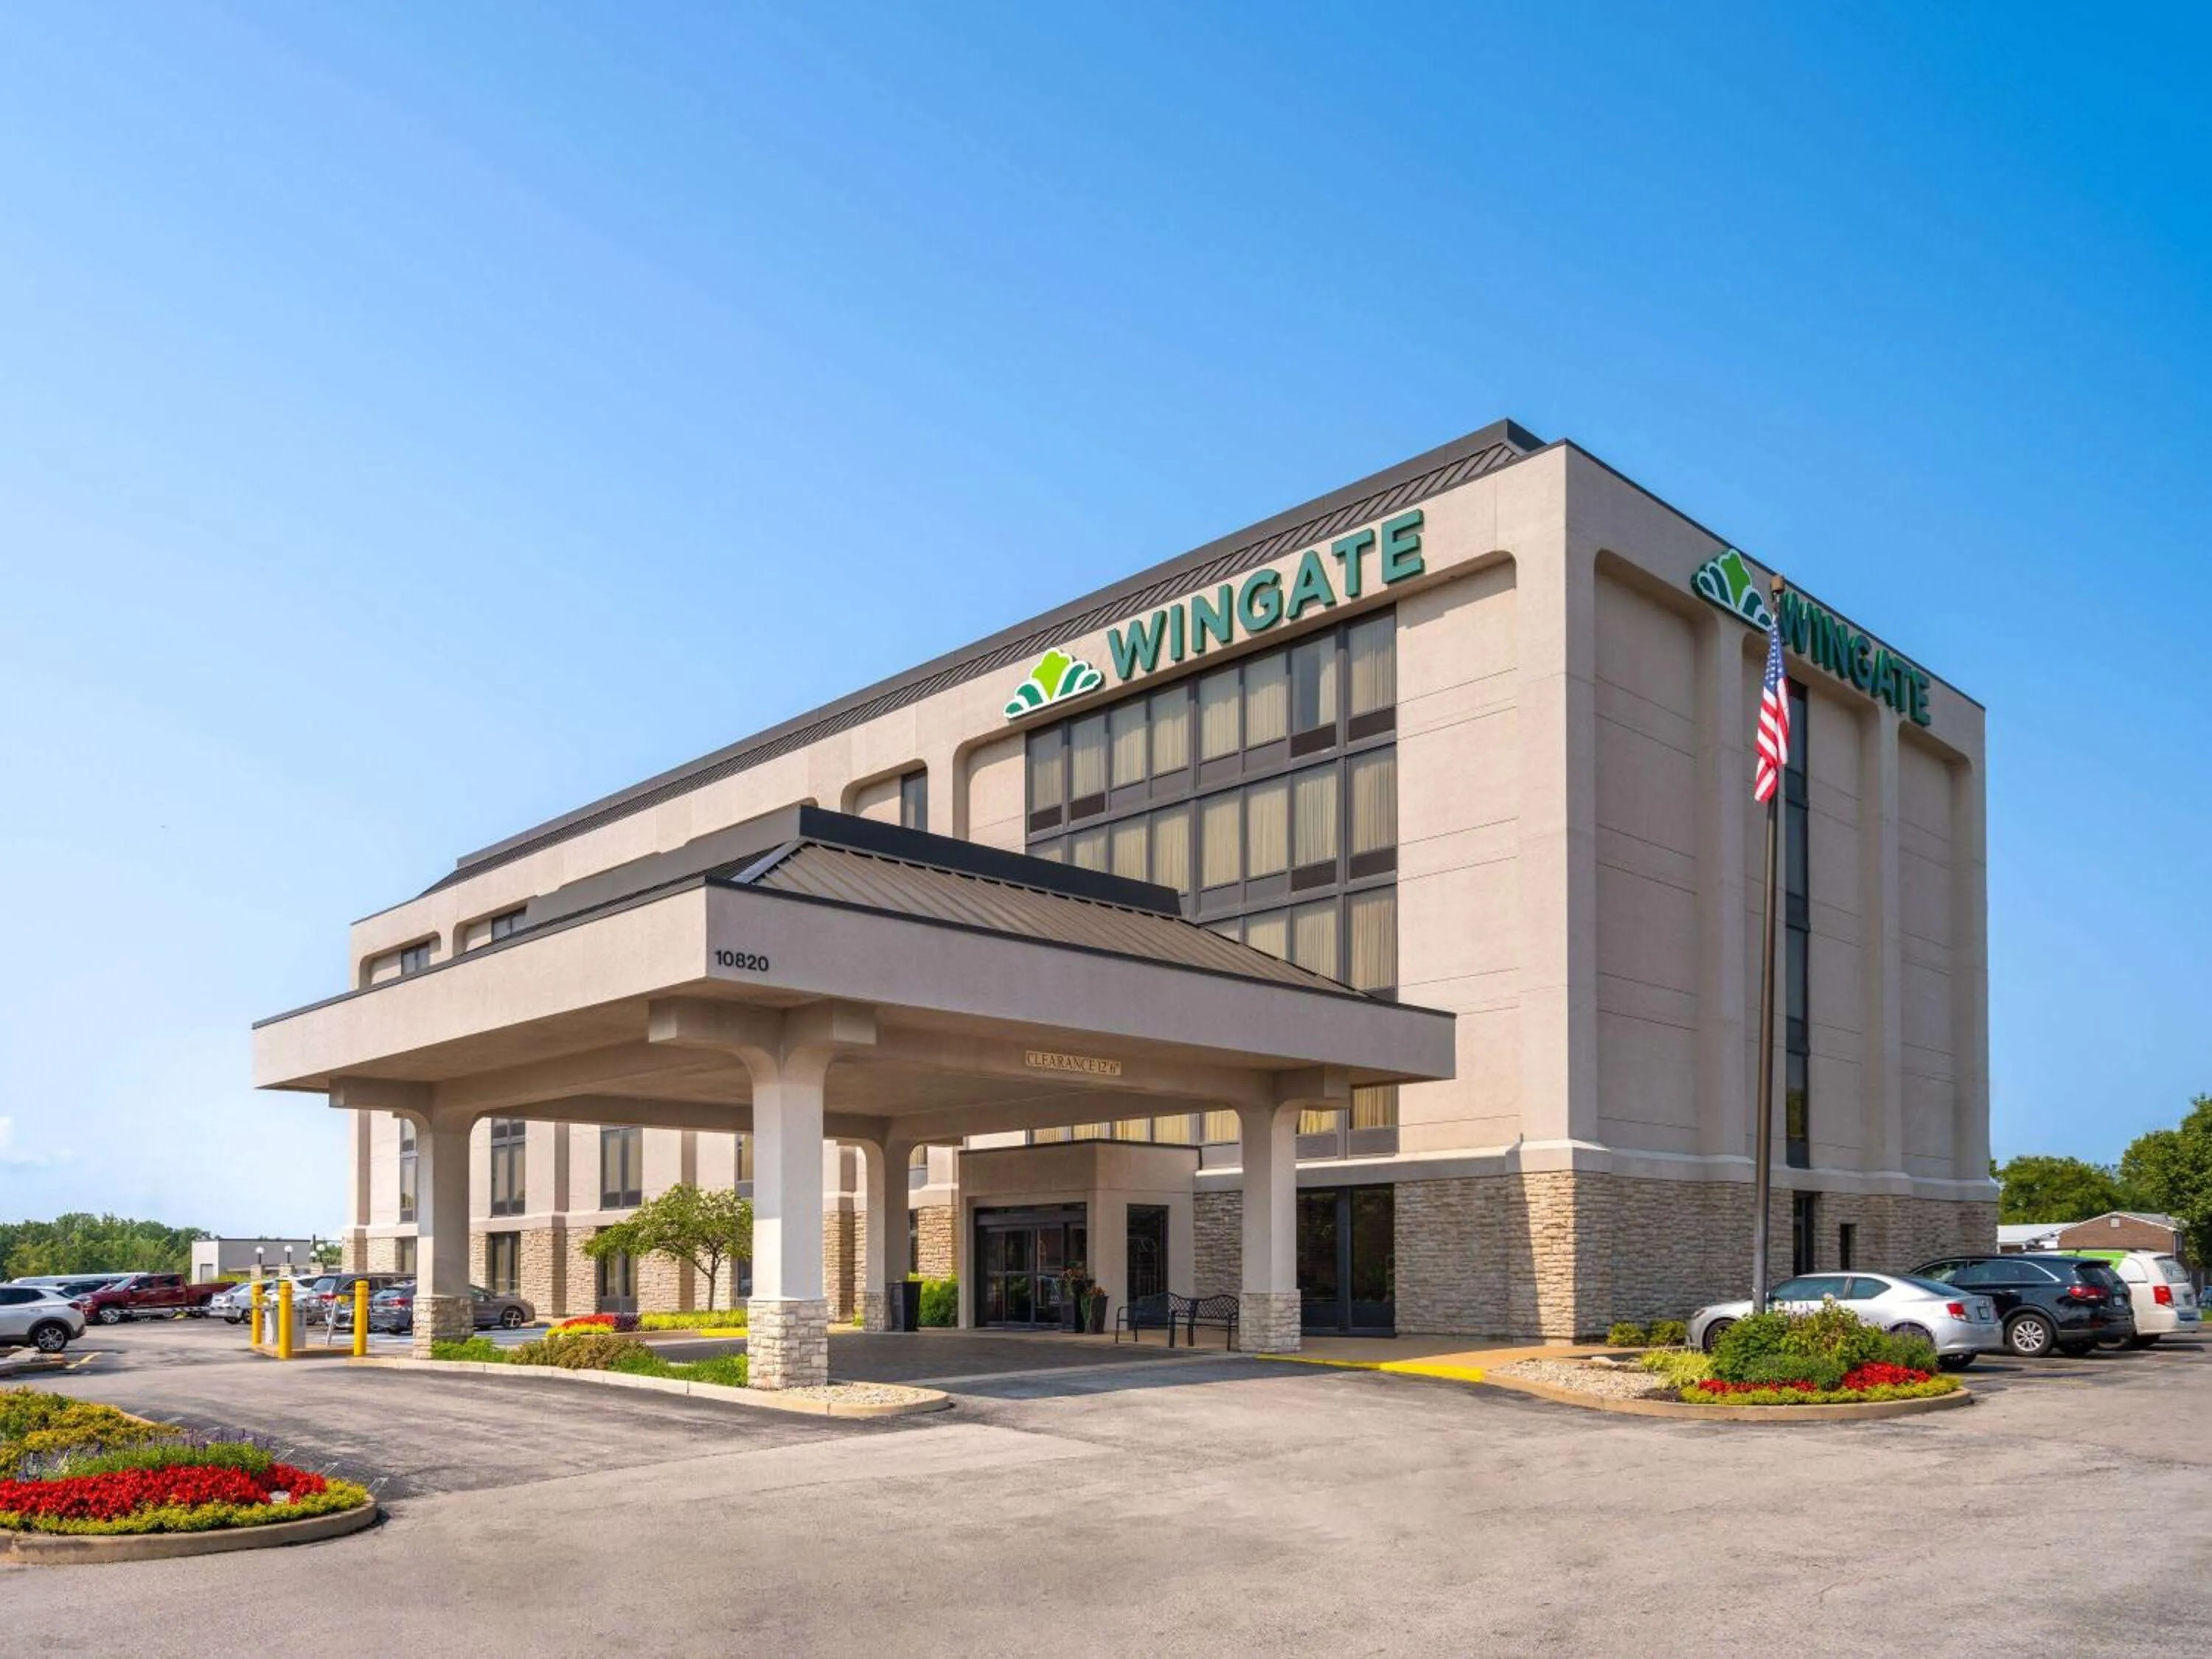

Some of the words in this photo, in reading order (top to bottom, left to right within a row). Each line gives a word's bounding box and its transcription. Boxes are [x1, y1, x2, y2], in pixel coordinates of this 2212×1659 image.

[1107, 509, 1425, 680] WINGATE
[1778, 591, 1930, 726] WINGATE
[714, 949, 769, 972] 10820
[1027, 1051, 1095, 1071] CLEARANCE
